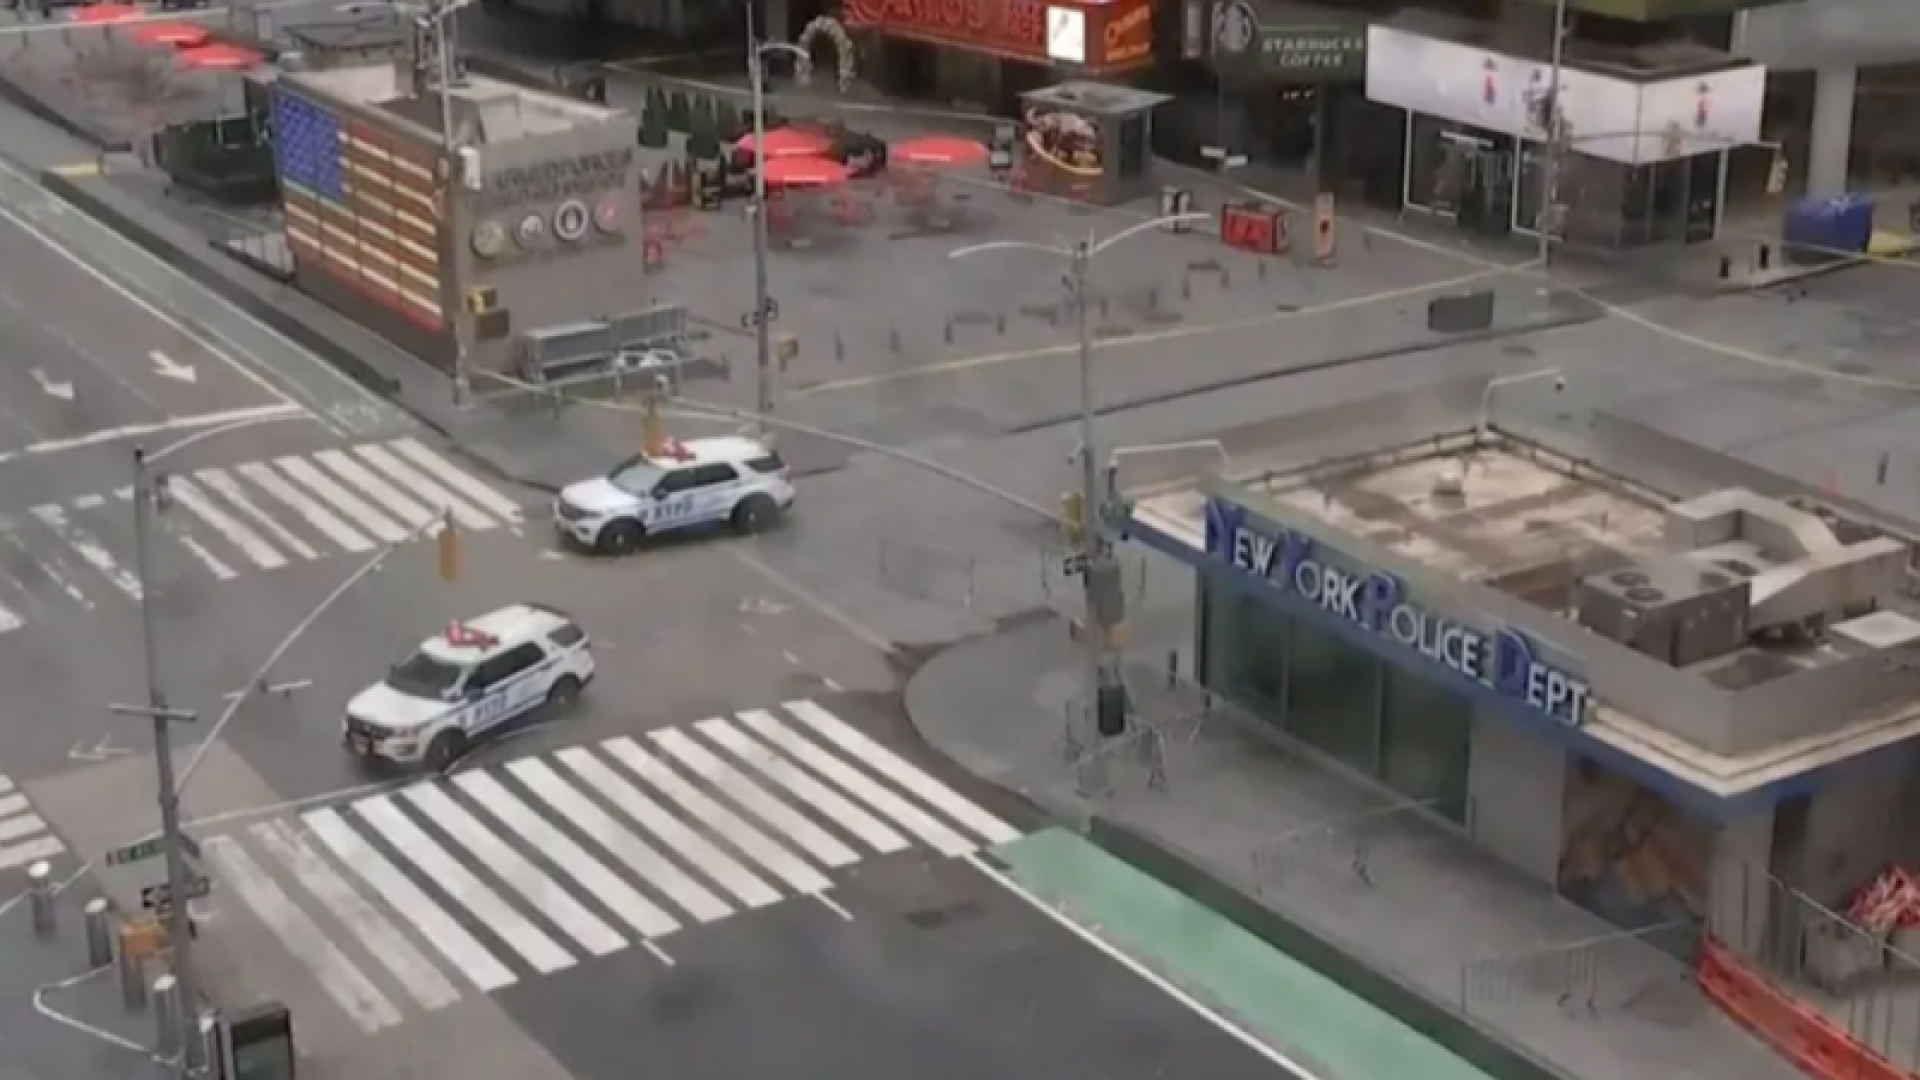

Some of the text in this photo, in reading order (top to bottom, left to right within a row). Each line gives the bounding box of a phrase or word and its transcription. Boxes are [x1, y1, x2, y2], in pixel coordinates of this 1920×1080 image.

[1262, 36, 1364, 53] STARBUCKS
[1279, 52, 1343, 68] COFFEE
[1206, 497, 1589, 727] NEW YORK POLICE DEPT
